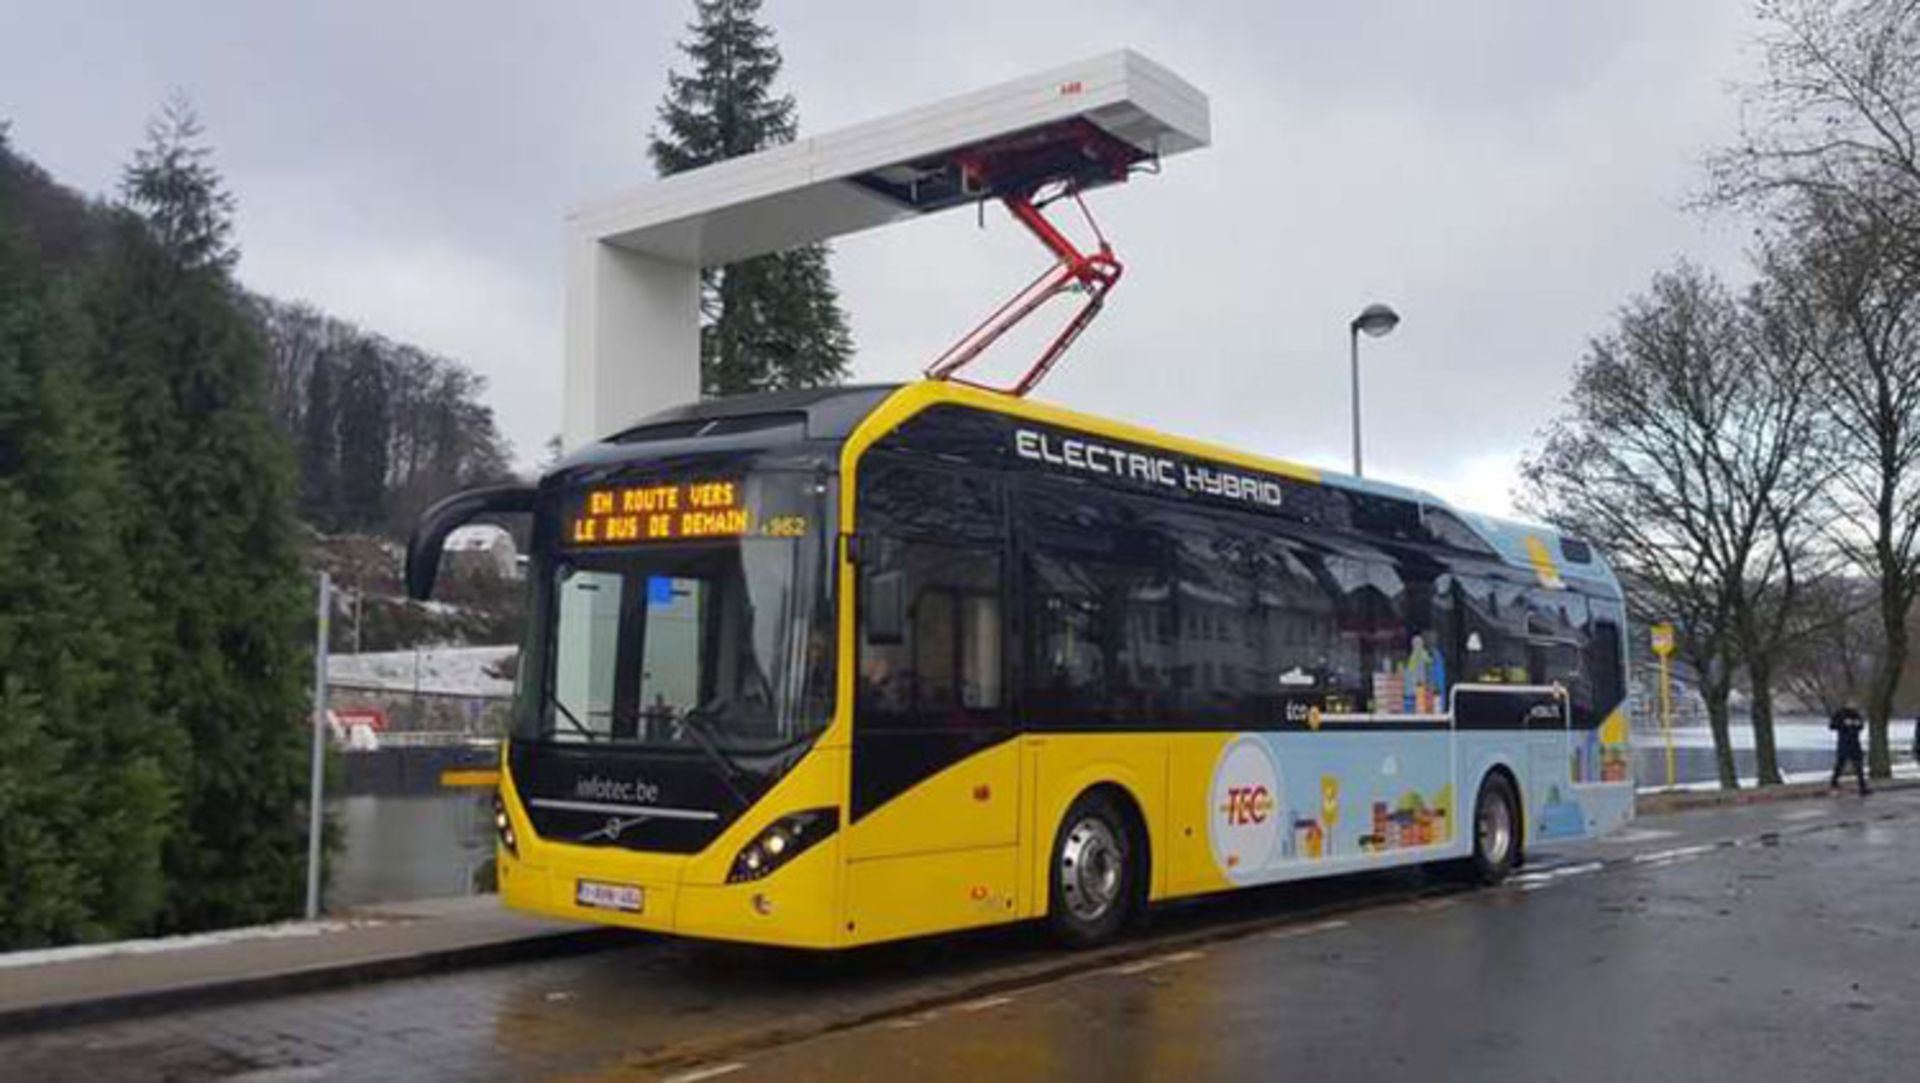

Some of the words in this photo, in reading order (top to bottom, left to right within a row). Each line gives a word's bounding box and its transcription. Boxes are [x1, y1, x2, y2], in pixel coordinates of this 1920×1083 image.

[1015, 428, 1177, 486] ELECTRIC
[1182, 464, 1283, 507] HYBRID
[623, 486, 679, 512] ROUTE
[689, 481, 735, 507] VERS
[574, 518, 596, 541] LE
[606, 515, 638, 540] BUS
[649, 513, 670, 538] DE
[682, 509, 749, 535] DEMAIN
[576, 773, 660, 803] infotec.be
[1227, 786, 1269, 826] TEC
